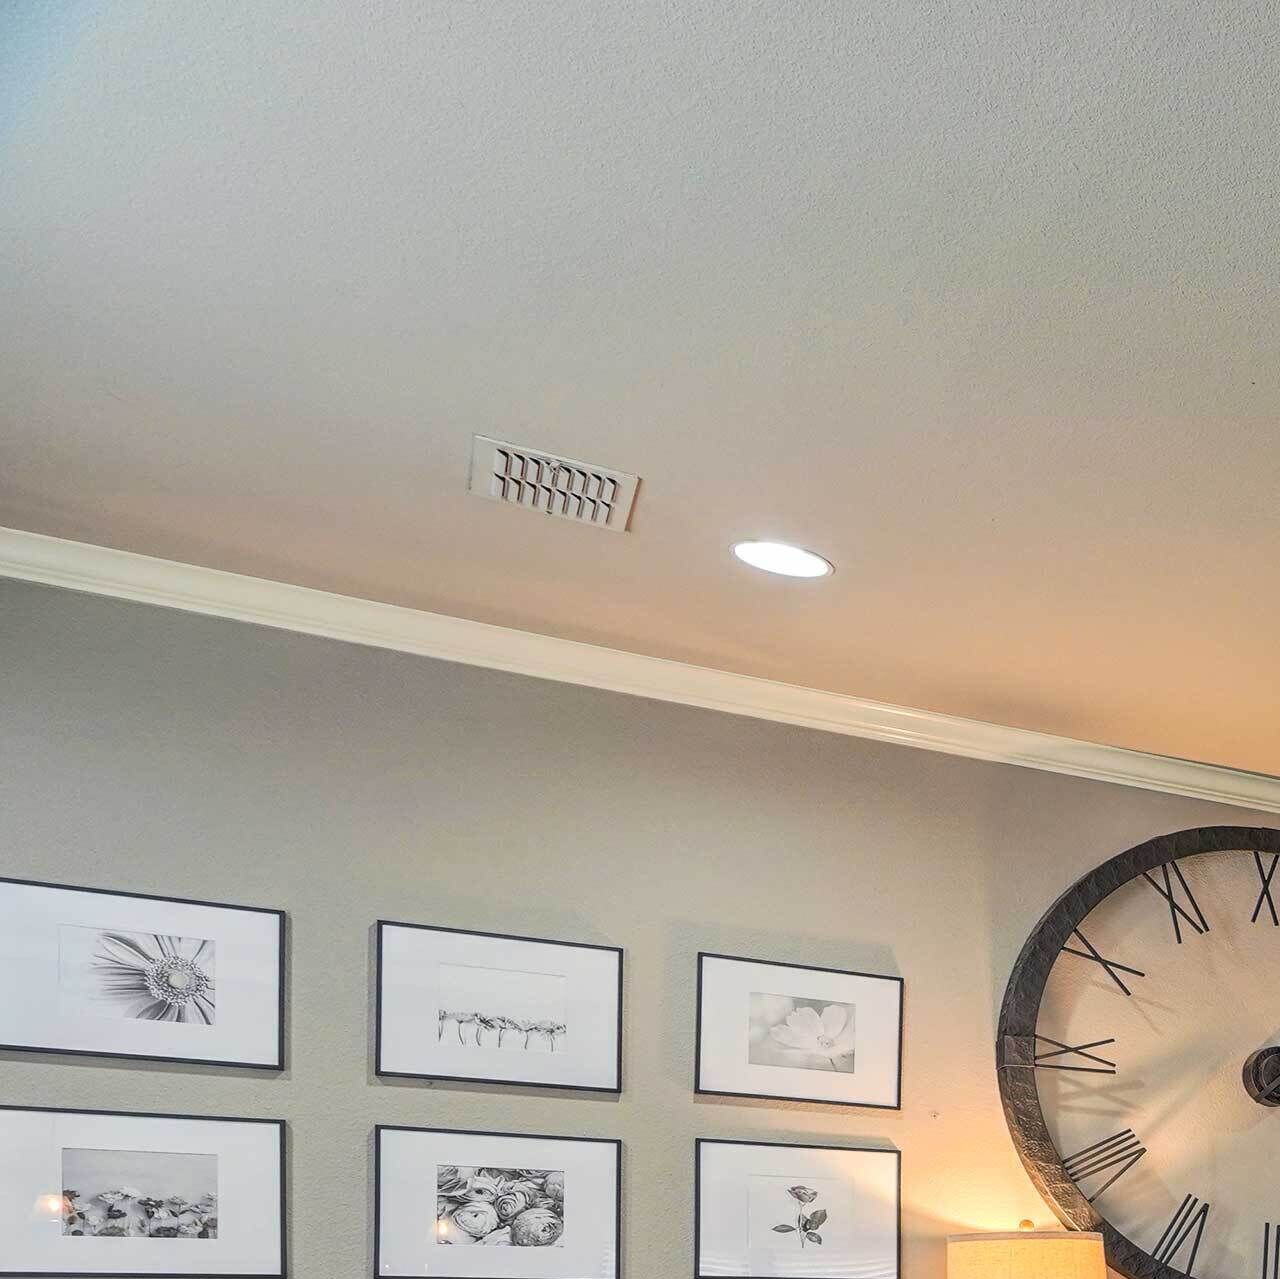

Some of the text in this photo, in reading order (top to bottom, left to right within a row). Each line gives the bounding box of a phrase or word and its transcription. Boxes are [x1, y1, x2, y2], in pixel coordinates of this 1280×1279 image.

[1142, 861, 1210, 944] XI
[1061, 928, 1146, 996] X
[1034, 1033, 1116, 1075] IX
